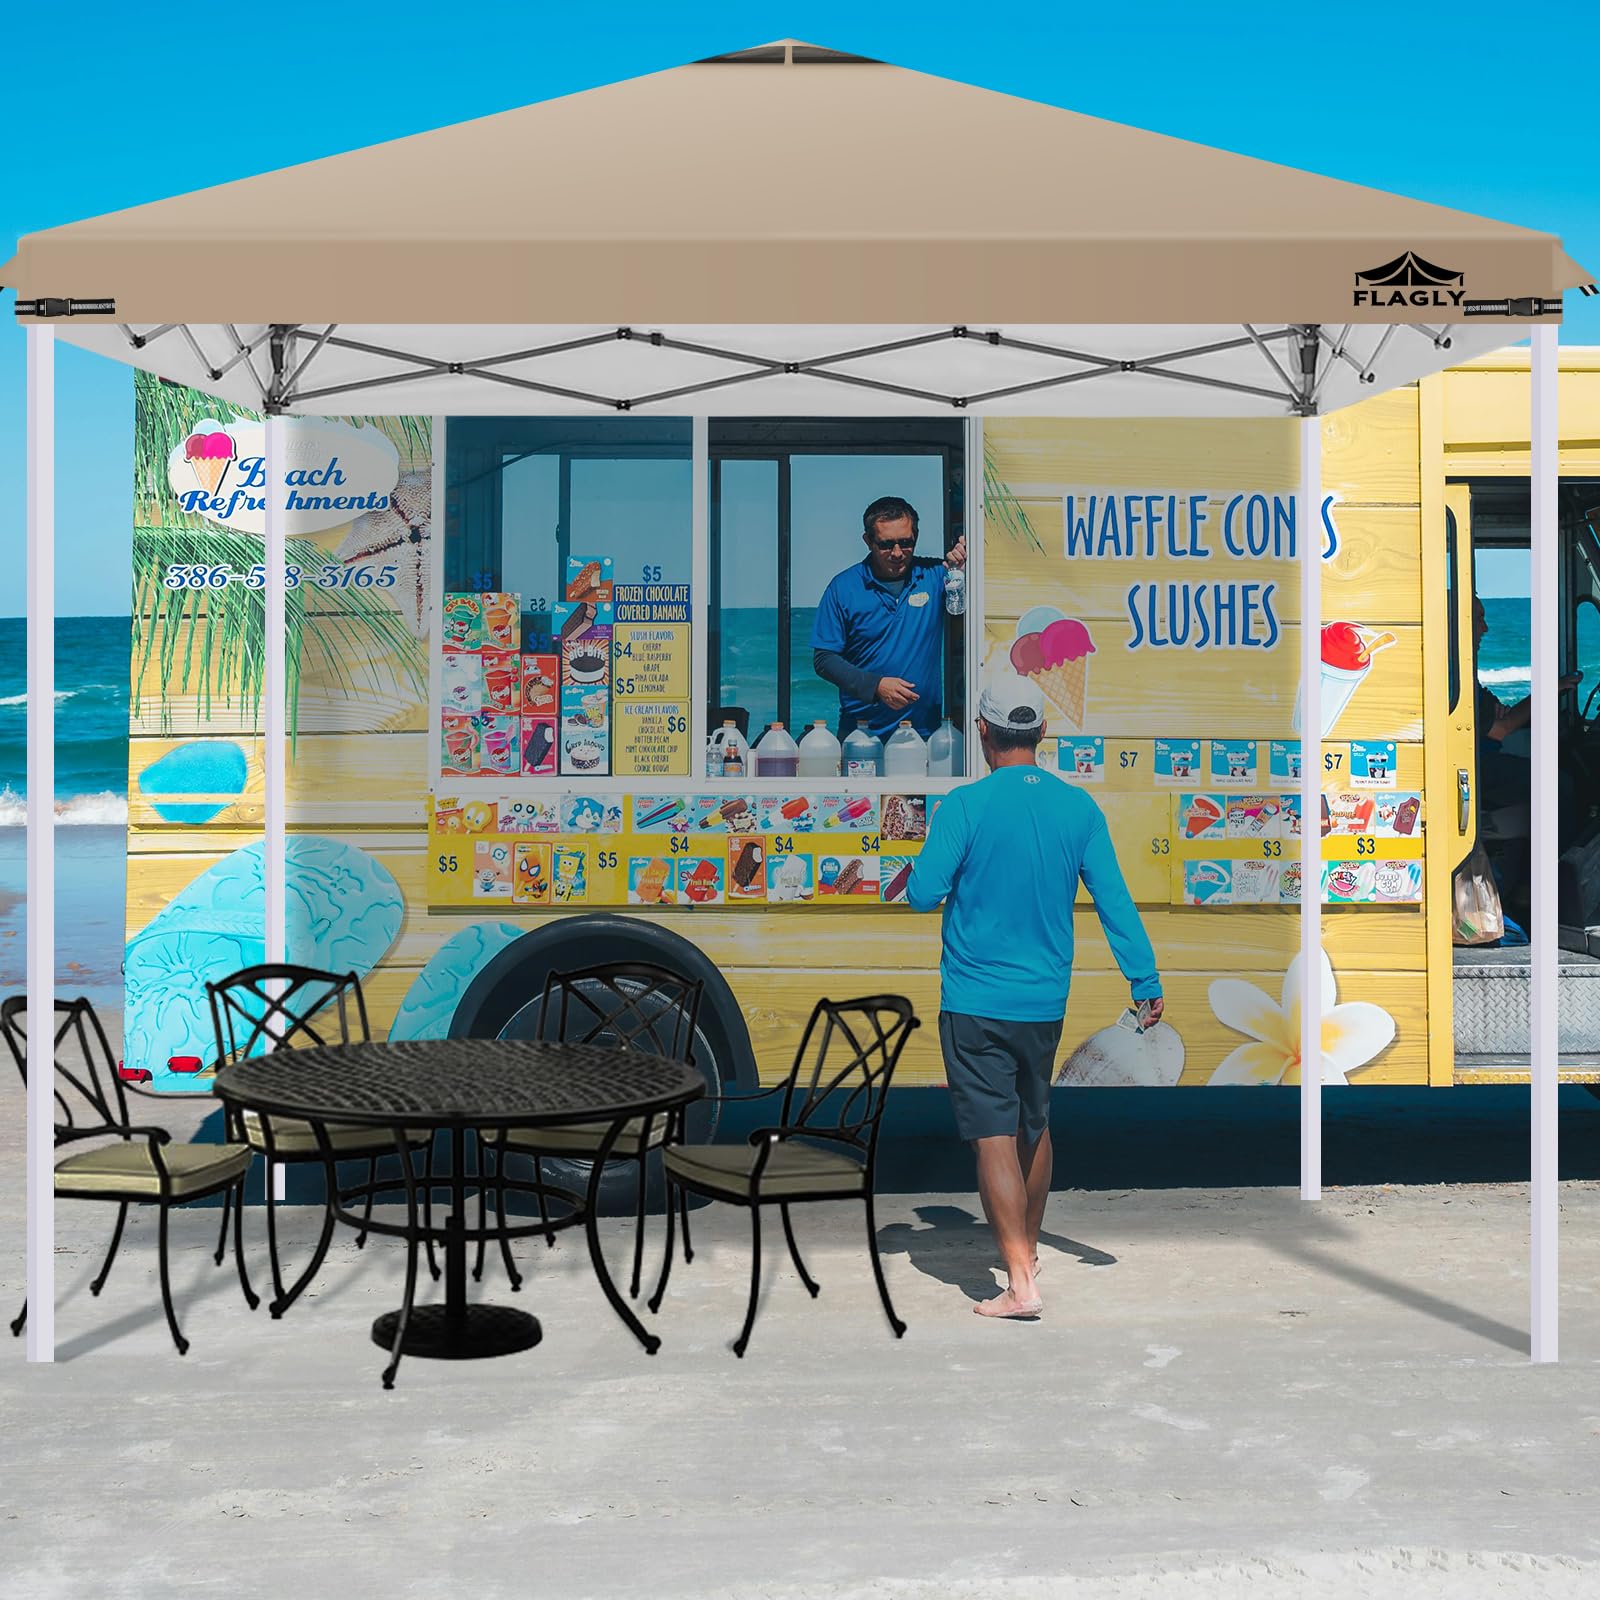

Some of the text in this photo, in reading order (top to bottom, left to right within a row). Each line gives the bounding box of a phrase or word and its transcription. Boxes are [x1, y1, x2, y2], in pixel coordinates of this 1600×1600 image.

[1353, 290, 1466, 306] FLAGLY
[236, 457, 346, 488] Bach
[180, 490, 390, 519] Refrehments
[1066, 494, 1337, 559] WAFFLE CONS
[166, 565, 399, 589] 386-58-3165
[472, 572, 493, 591] $5
[642, 565, 662, 583] $5
[615, 585, 643, 602] FROZEN
[645, 585, 689, 602] CHOCOLATE
[617, 604, 687, 621] COVERED BANANAS
[1128, 584, 1278, 649] SLUSHES
[528, 632, 547, 650] $5
[630, 631, 674, 641] SLUSH FLAVORS
[614, 641, 633, 659] $4
[643, 663, 660, 672] GRAPE
[616, 677, 635, 696] $5
[648, 674, 669, 682] COLADA
[638, 684, 665, 693] LEMONADE
[624, 705, 679, 715] ICE CREAM FLAVORS
[641, 716, 663, 725] VANILLA
[667, 715, 686, 734] $6
[638, 726, 665, 734] CHOCOLATE
[634, 736, 670, 744] BUTTER PECAN
[638, 745, 666, 753] CHOCOLATE
[634, 755, 651, 763] BLACK
[1120, 750, 1138, 769] $7
[1324, 752, 1343, 771] $7
[670, 836, 689, 854] $4
[775, 835, 794, 854] $4
[861, 835, 881, 853] $4
[1151, 838, 1170, 855] $3
[1263, 840, 1282, 858] $3
[1357, 837, 1375, 855] $3
[438, 855, 458, 874] $5
[598, 851, 618, 870] $5
